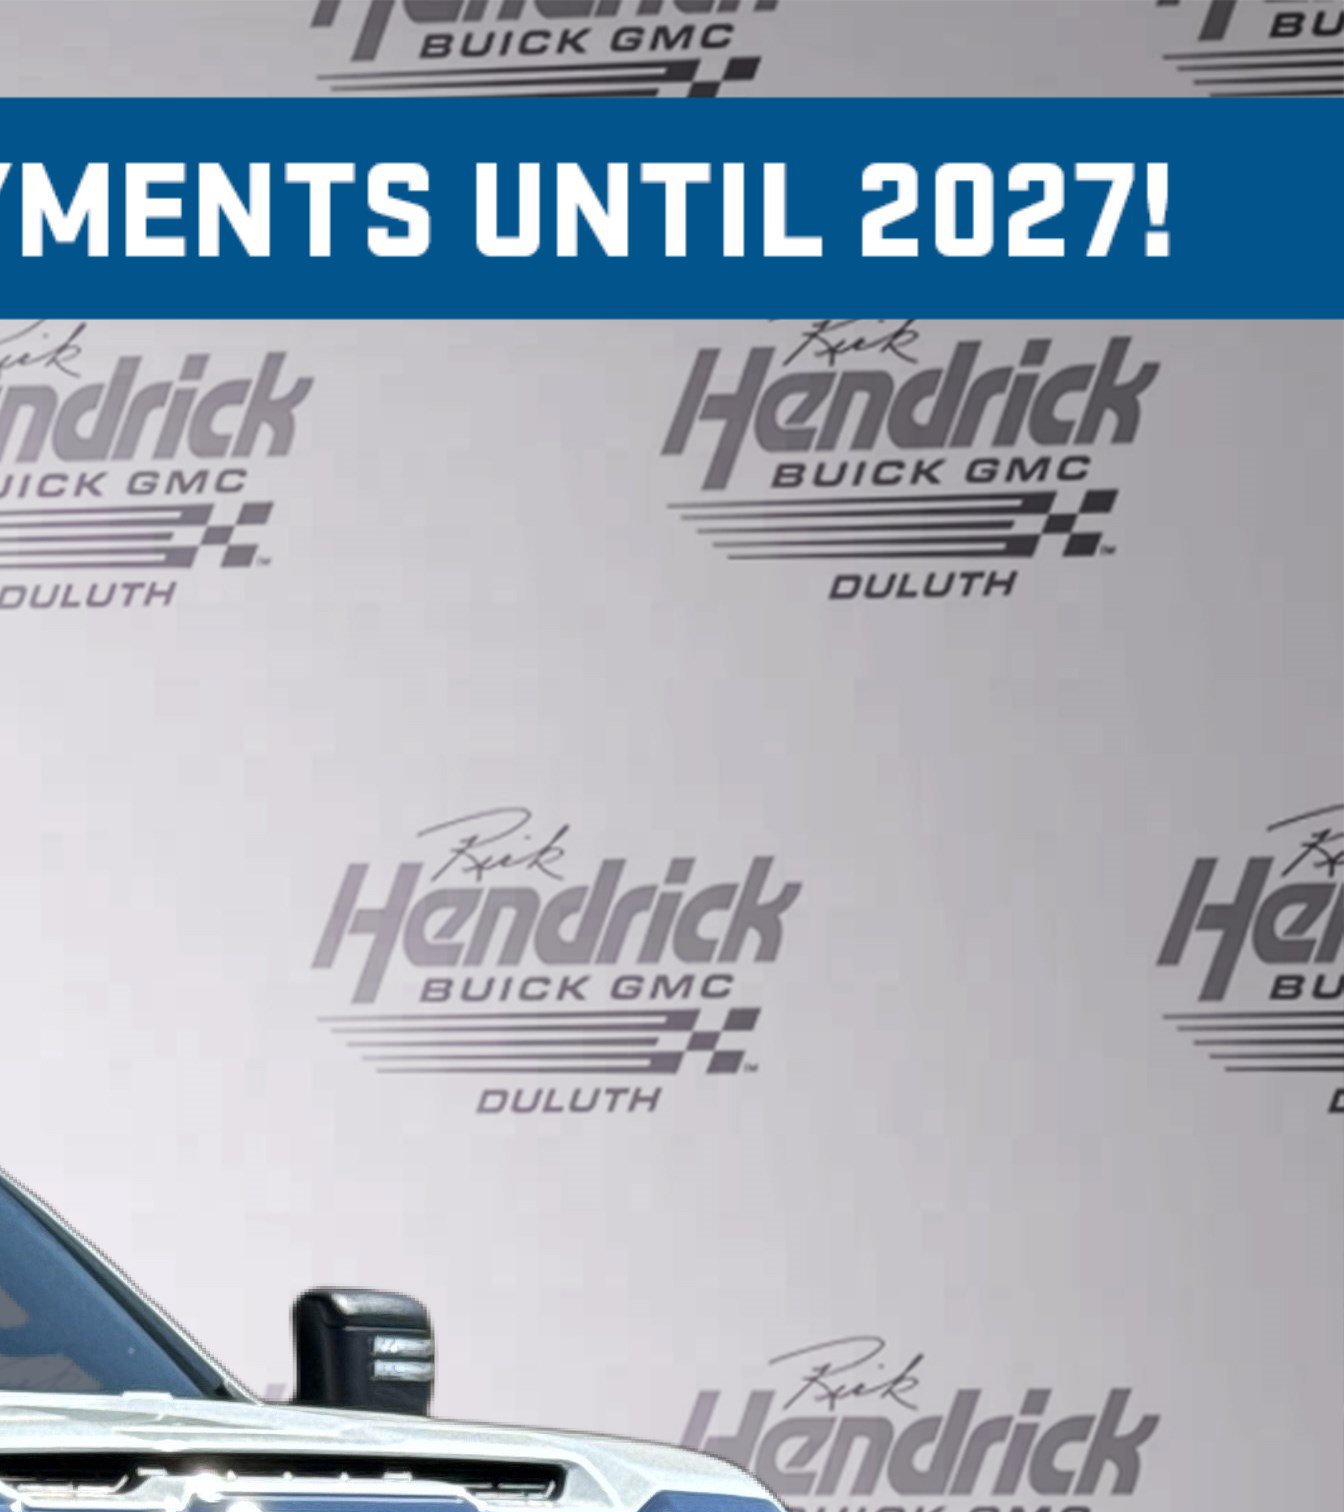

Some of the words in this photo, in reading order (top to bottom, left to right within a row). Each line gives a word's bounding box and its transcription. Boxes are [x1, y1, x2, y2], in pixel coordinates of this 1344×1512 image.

[419, 27, 591, 59] BUICK
[610, 23, 734, 52] GMC
[660, 336, 1161, 490] Hendrick
[126, 468, 248, 496] GMC
[770, 458, 945, 489] BUICK
[965, 455, 1092, 484] GMC
[829, 570, 1018, 601] DULUTH
[311, 855, 803, 1005] Hendrick
[418, 975, 591, 1003] BUICK
[609, 973, 736, 1001] GMC
[475, 1086, 662, 1114] DULUTH
